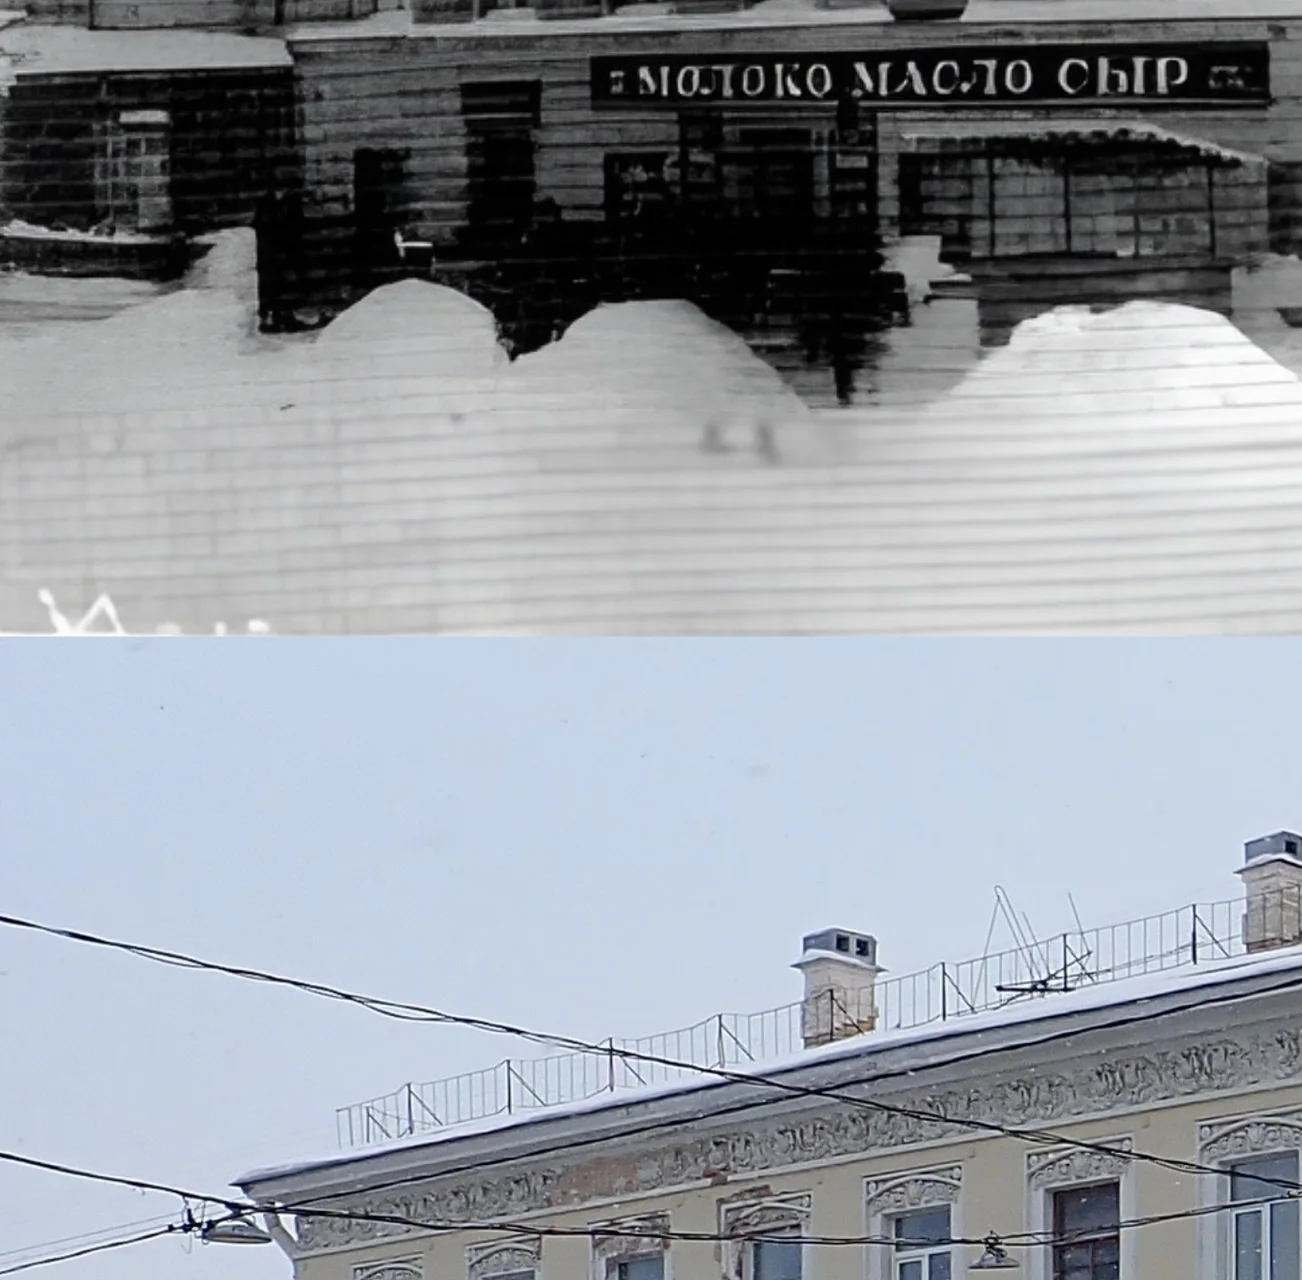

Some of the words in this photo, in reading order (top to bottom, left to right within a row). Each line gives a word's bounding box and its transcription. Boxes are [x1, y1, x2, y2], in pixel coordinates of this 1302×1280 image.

[638, 63, 833, 98] МОЛОКО
[851, 58, 1034, 97] МАСЛО
[1056, 56, 1190, 96] СЫР
